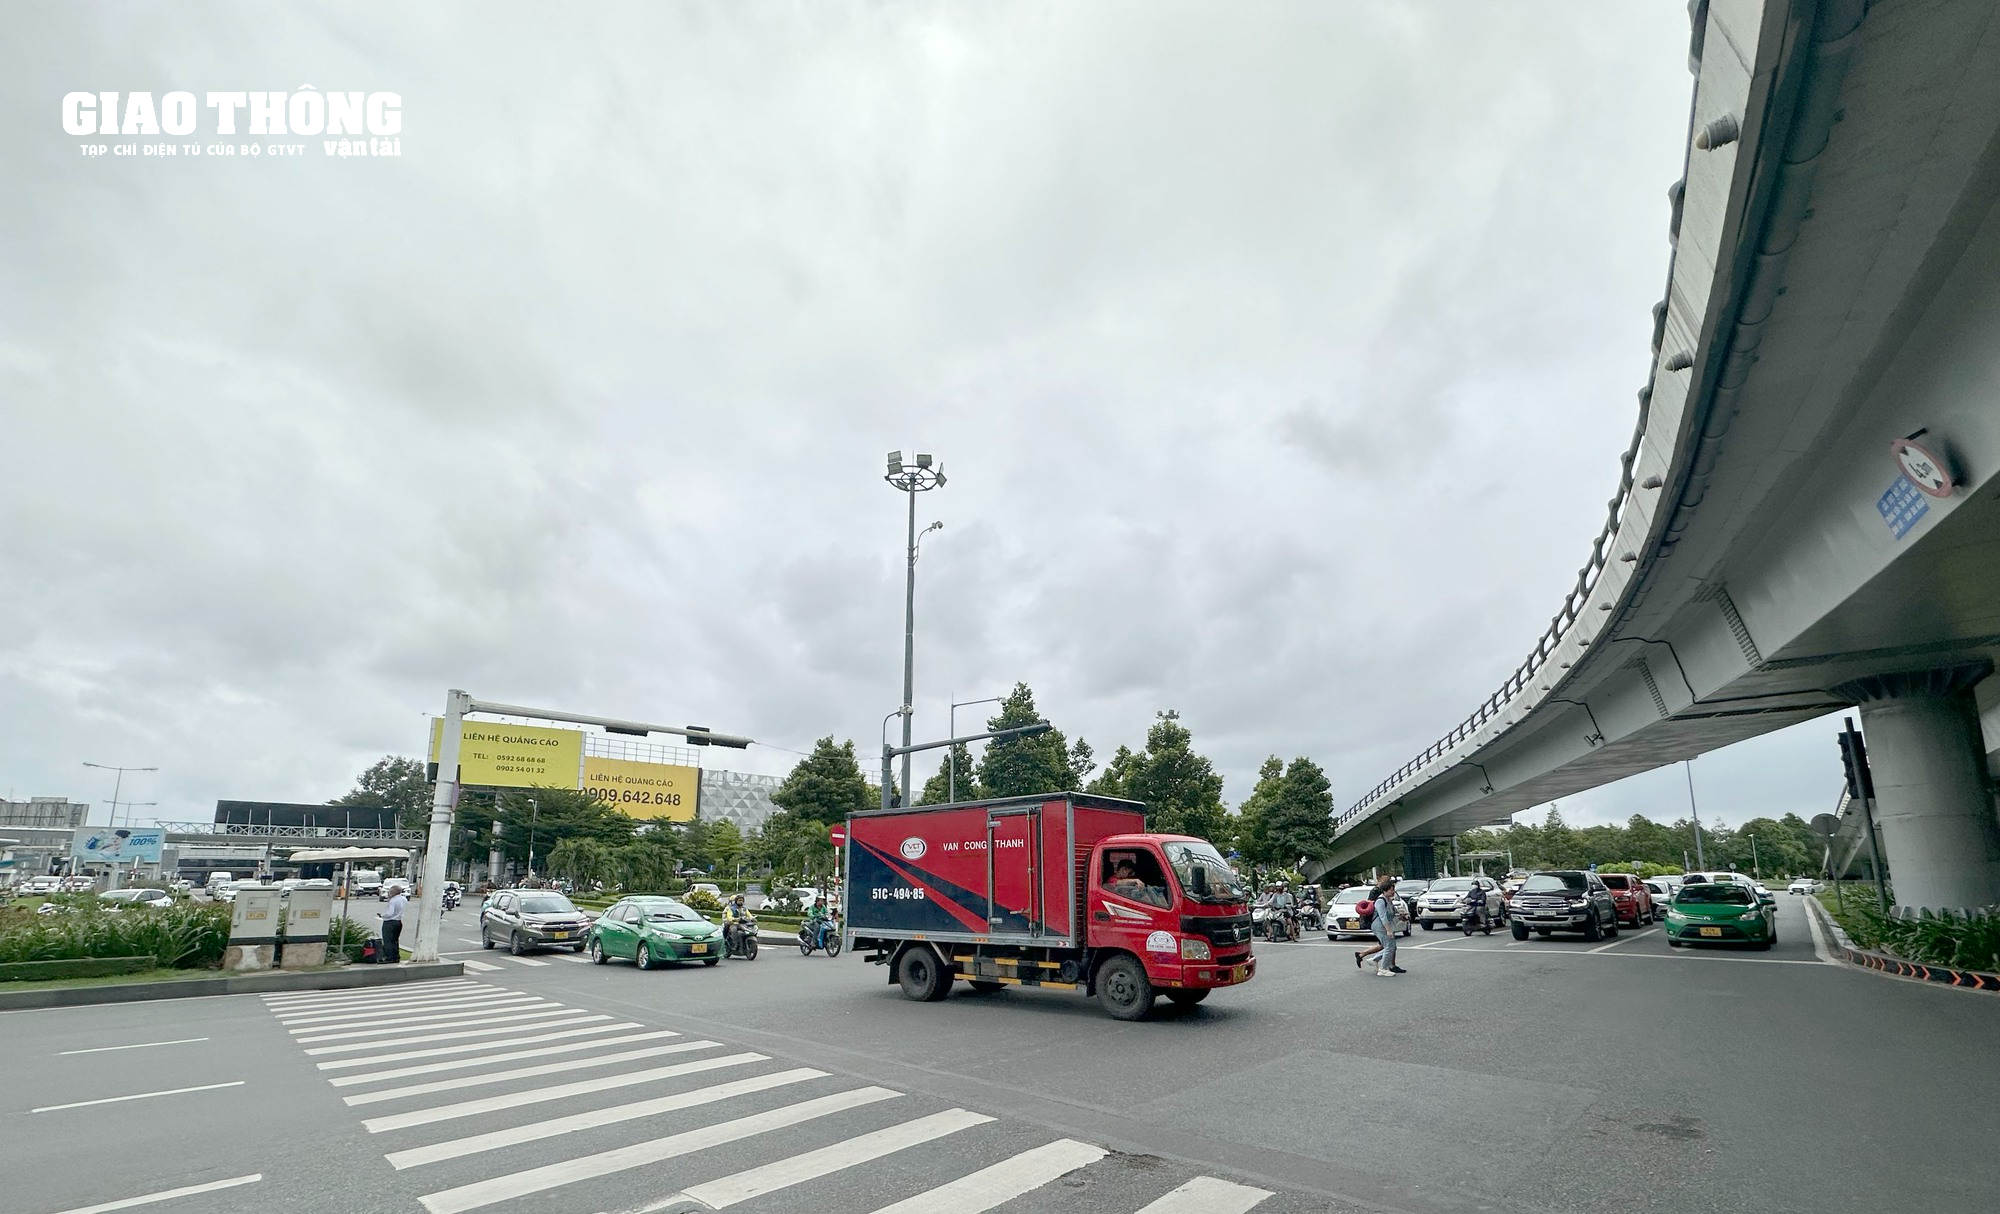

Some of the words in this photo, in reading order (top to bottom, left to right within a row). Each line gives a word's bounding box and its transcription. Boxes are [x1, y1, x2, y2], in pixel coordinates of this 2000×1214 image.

[463, 732, 486, 741] LIÊN
[487, 734, 501, 743] HỆ
[502, 735, 538, 746] QUẢNG
[539, 739, 560, 747] CÁO
[473, 752, 489, 760] TEL:
[590, 773, 610, 782] LIÊN
[611, 775, 624, 784] HỆ
[625, 776, 655, 786] QUẢNG
[656, 779, 674, 788] CÁO
[129, 838, 158, 846] 100%
[942, 842, 959, 851] VAN
[964, 840, 988, 851] CONG
[994, 839, 1024, 849] THANH
